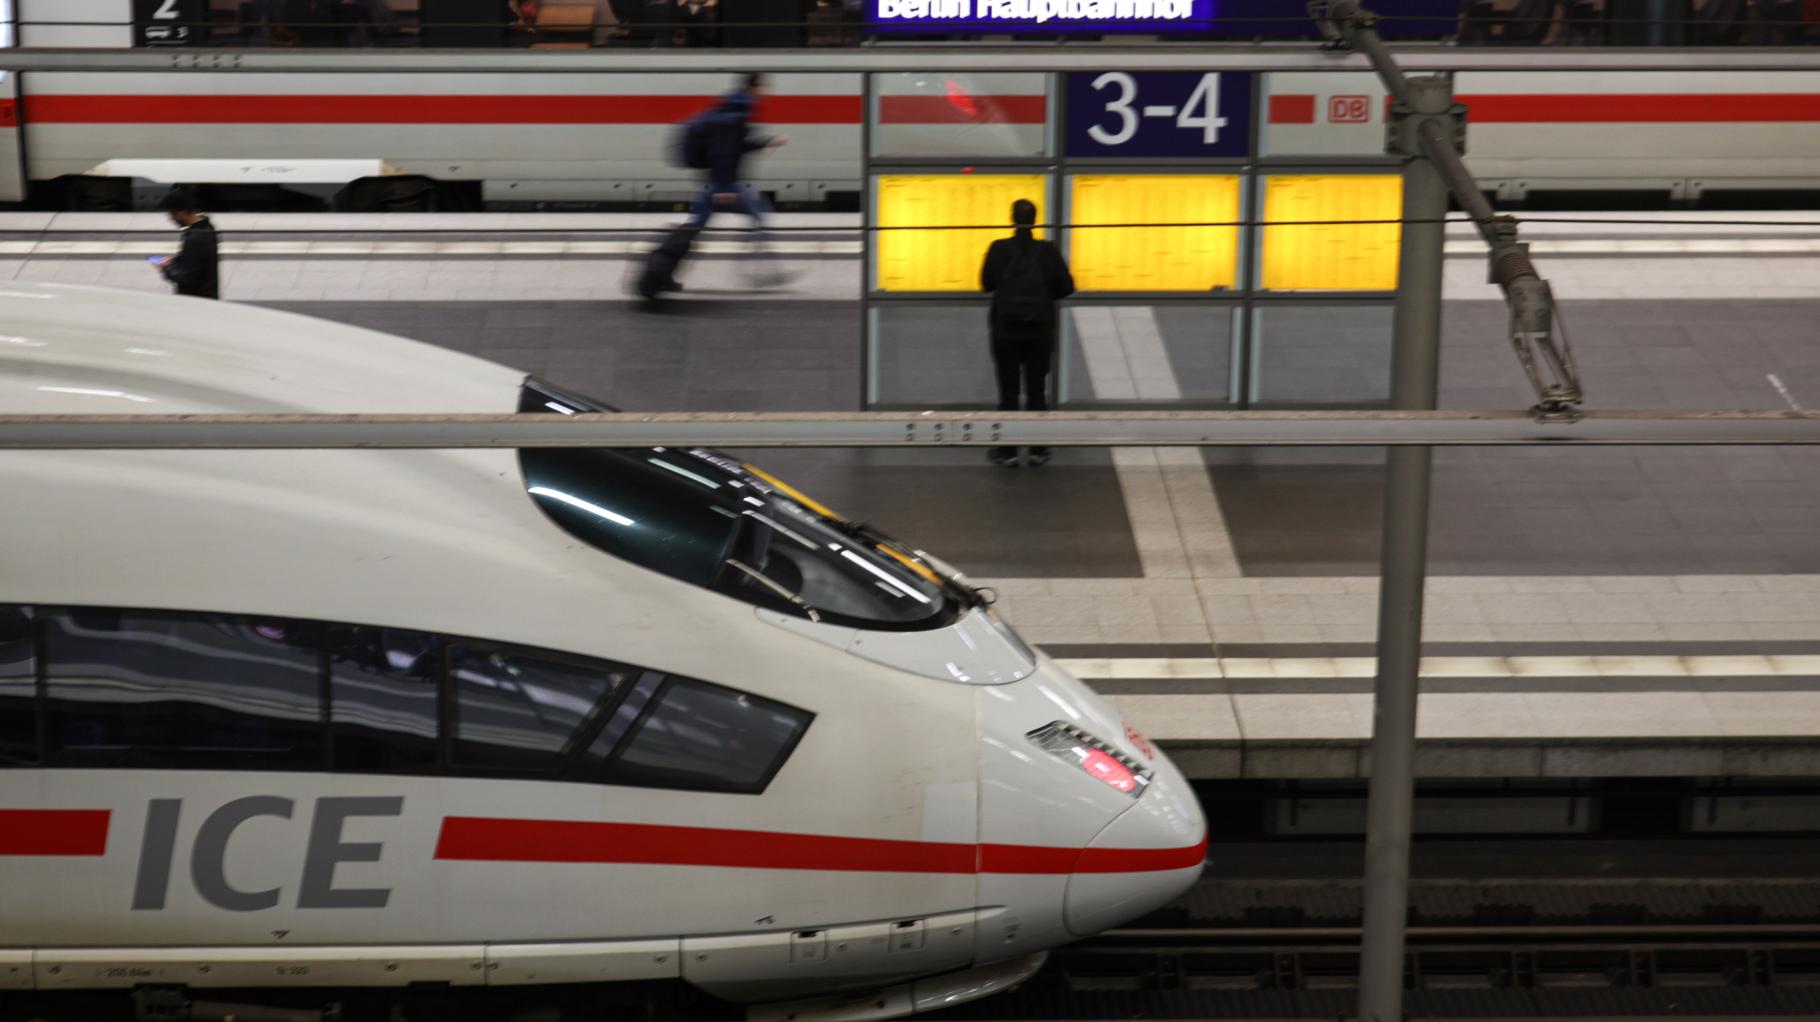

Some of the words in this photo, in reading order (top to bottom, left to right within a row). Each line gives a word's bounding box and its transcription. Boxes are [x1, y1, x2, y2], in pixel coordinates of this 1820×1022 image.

[878, 0, 971, 19] Berlin
[976, 0, 1194, 23] Hauptbahnhof
[1087, 72, 1228, 146] 3-4
[1332, 98, 1366, 120] DB
[131, 794, 405, 912] ICE
